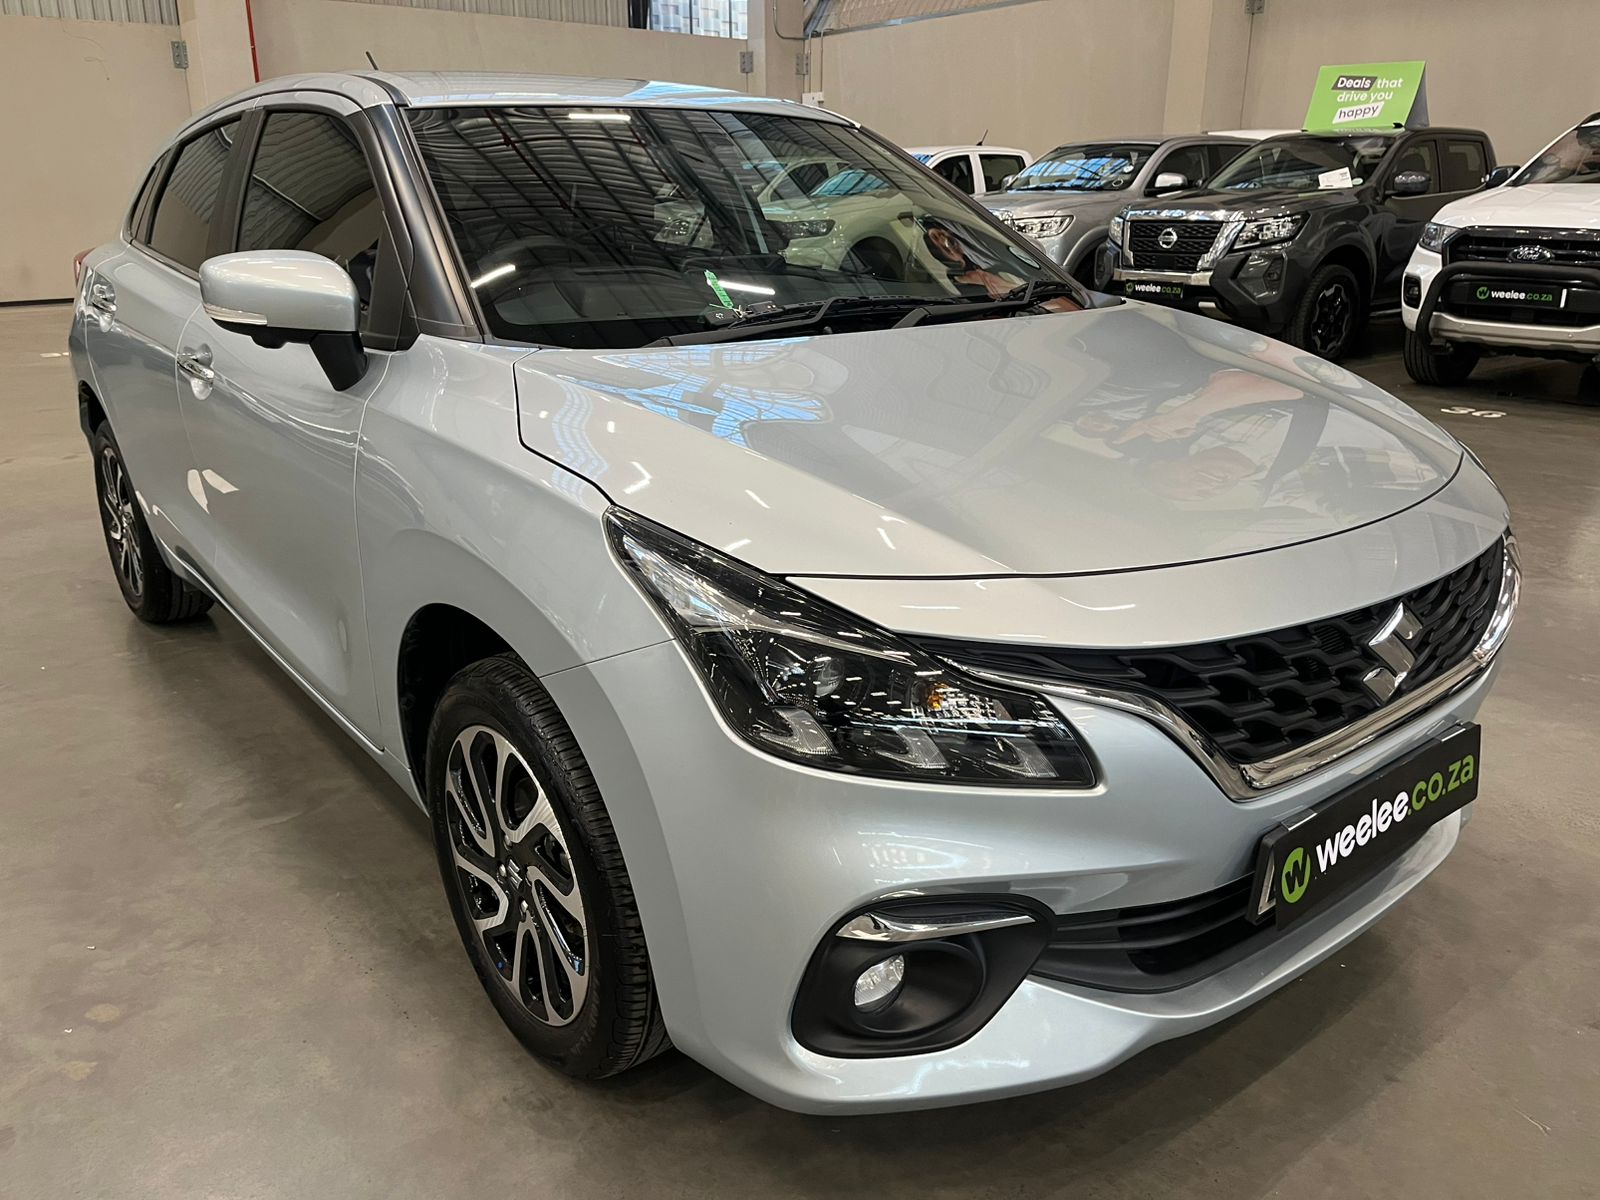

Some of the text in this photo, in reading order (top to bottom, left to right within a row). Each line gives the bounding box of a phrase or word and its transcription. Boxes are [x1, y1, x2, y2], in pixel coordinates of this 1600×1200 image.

[1337, 77, 1403, 88] Deals that
[1337, 91, 1394, 102] drive you
[1338, 104, 1379, 119] happy
[1491, 290, 1552, 301] weelee.co.za
[1316, 754, 1474, 873] weelee.co.za
